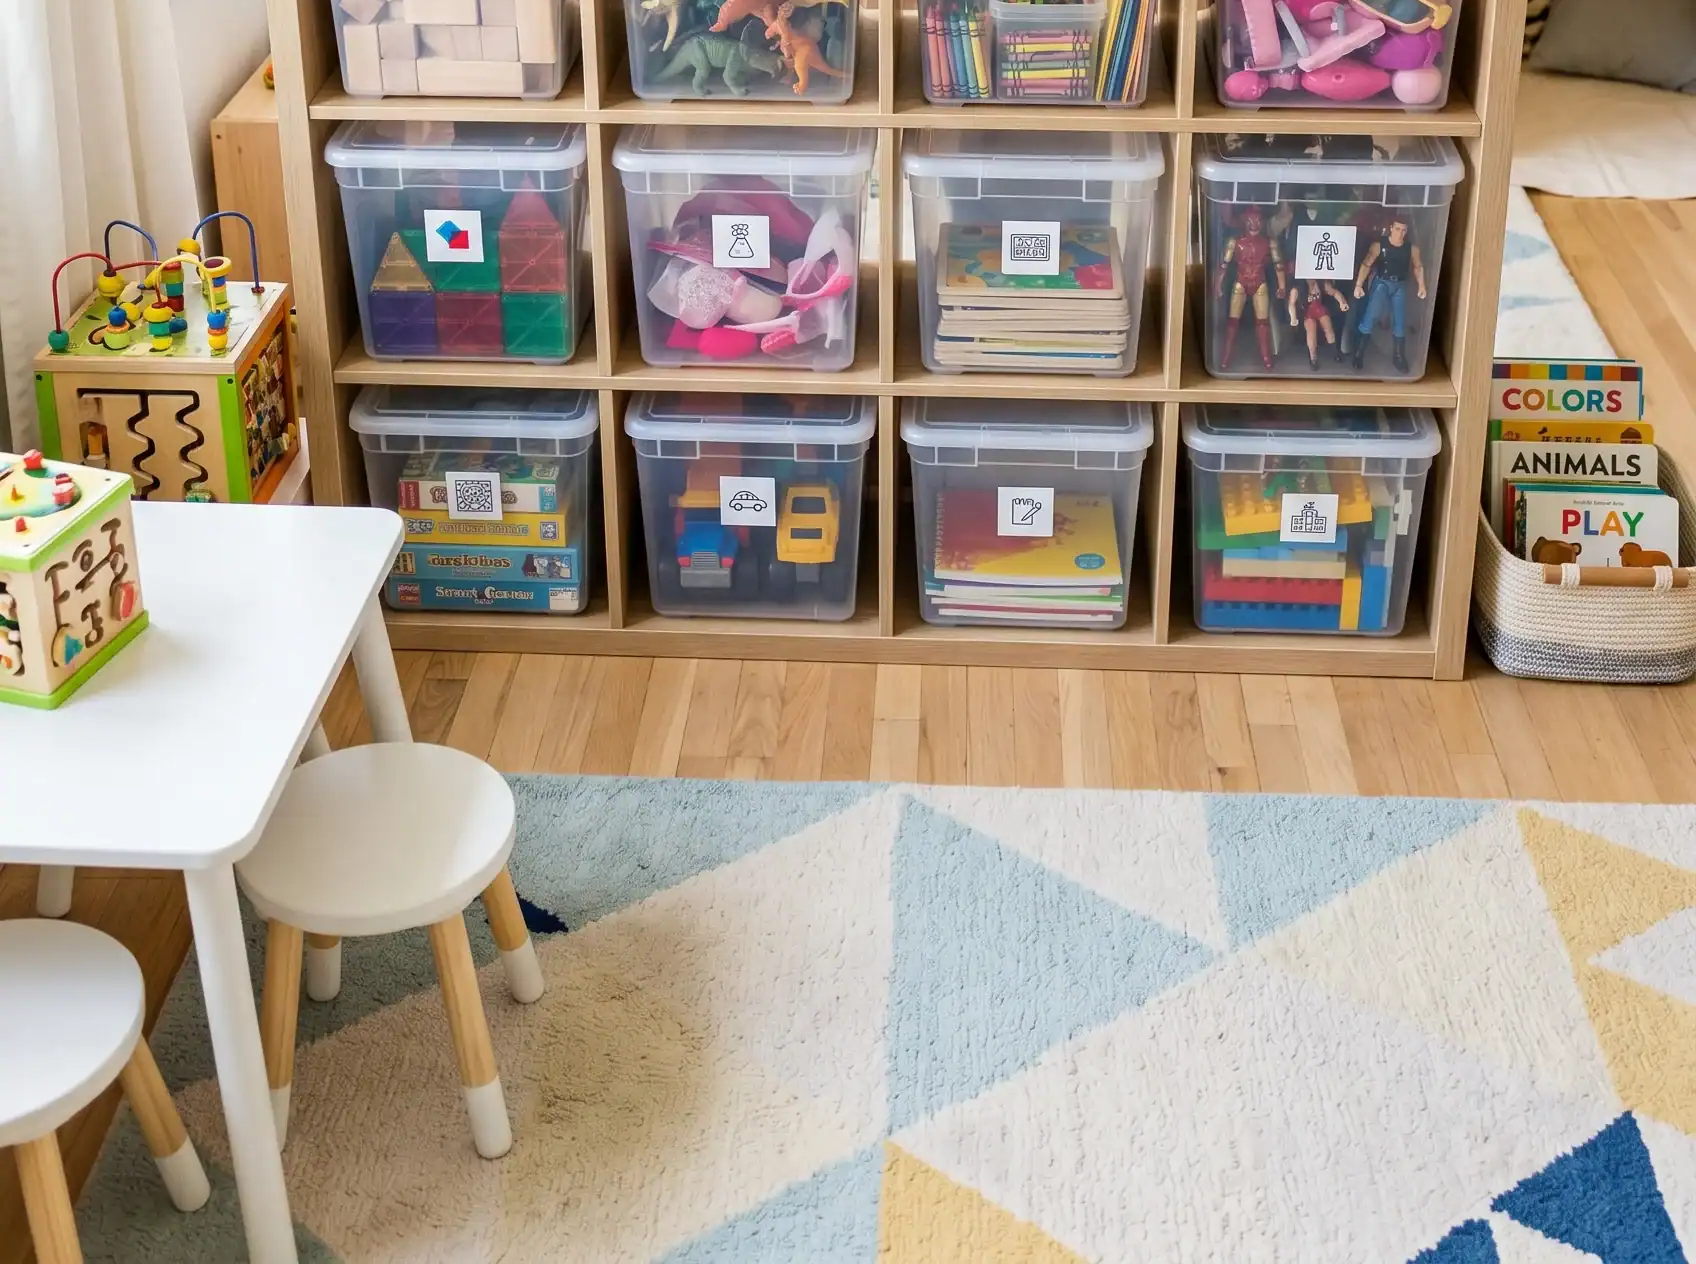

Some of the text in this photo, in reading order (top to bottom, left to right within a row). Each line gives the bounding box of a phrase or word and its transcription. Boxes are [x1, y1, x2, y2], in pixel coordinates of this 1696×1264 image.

[1502, 388, 1622, 413] COLORS
[1510, 451, 1641, 476] ANIMALS
[1562, 509, 1644, 537] PLAY
